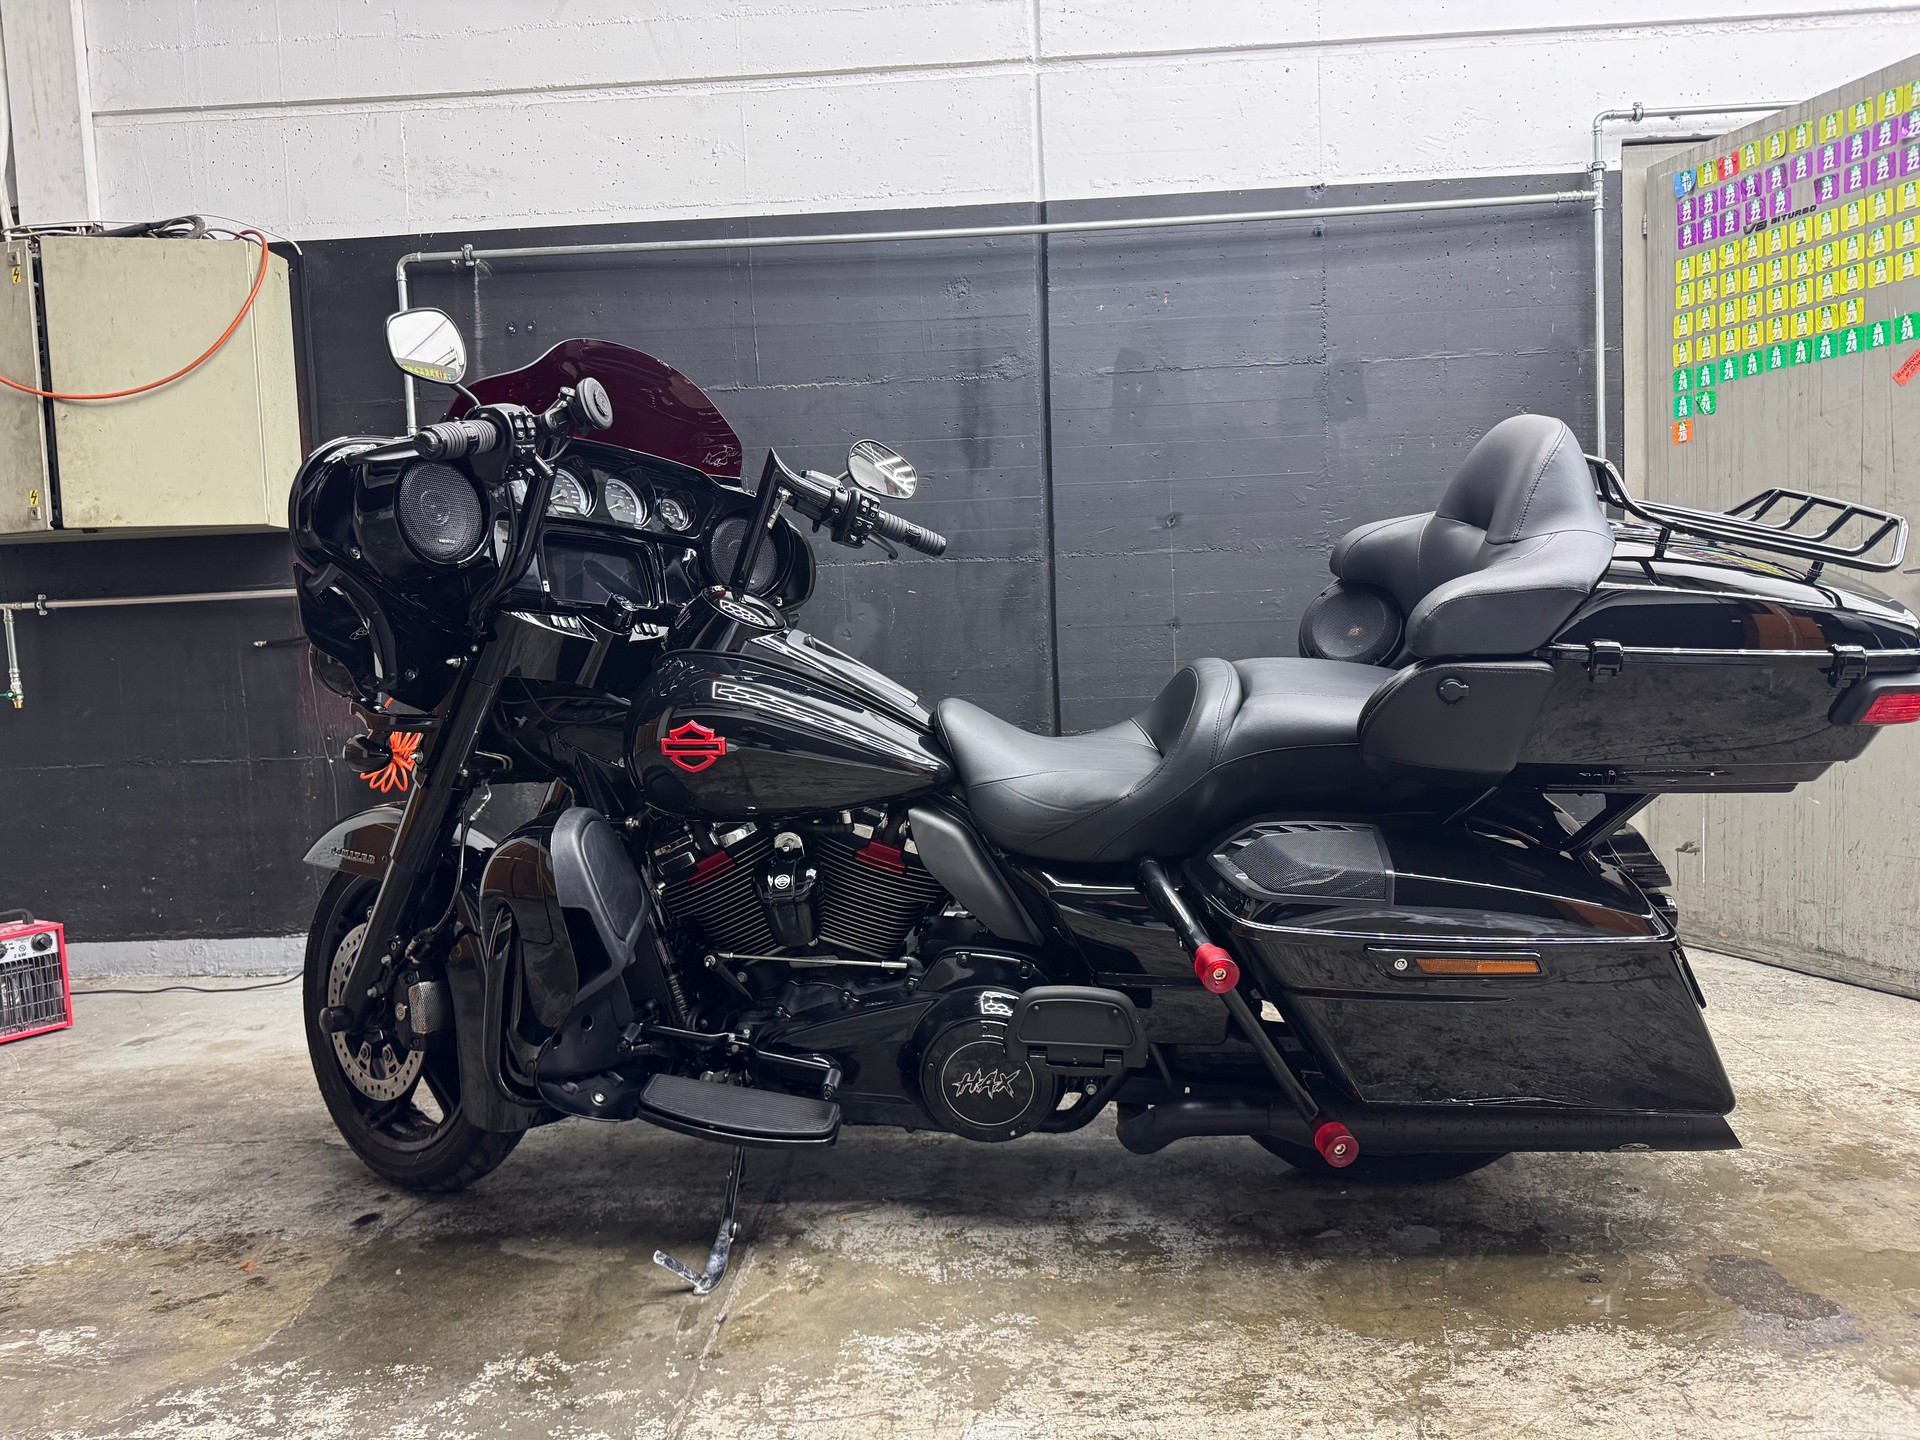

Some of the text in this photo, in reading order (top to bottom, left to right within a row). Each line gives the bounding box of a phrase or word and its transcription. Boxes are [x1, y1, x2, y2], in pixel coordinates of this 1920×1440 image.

[1885, 103, 1896, 117] 21
[1856, 115, 1866, 128] 21
[1826, 125, 1836, 139] 21
[1908, 120, 1920, 136] 22
[1796, 136, 1806, 149] 21
[1879, 133, 1891, 146] 22
[1771, 145, 1780, 159] 21
[1851, 145, 1863, 159] 22
[1746, 156, 1755, 167] 21
[1824, 156, 1834, 169] 22
[1907, 158, 1919, 171] 22
[1724, 166, 1733, 176] 20
[1796, 166, 1806, 179] 22
[1877, 166, 1889, 180] 22
[1704, 173, 1712, 184] 21
[1772, 177, 1781, 189] 22
[1850, 176, 1861, 189] 22
[1682, 181, 1692, 192] 19
[1746, 185, 1756, 197] 22
[1726, 193, 1735, 205] 22
[1822, 187, 1832, 200] 22
[1704, 202, 1713, 214] 22
[1775, 202, 1785, 213] 22
[1683, 210, 1691, 221] 22
[1743, 205, 1816, 234] V8 BITURBO
[1751, 210, 1760, 220] 22
[1725, 221, 1734, 232] 22
[1703, 228, 1712, 239] 22
[1683, 235, 1692, 245] 22
[1901, 325, 1913, 340] 24
[1846, 340, 1857, 352] 24
[1873, 333, 1883, 347] 24
[1796, 351, 1806, 363] 24
[1820, 346, 1831, 358] 24
[1771, 357, 1781, 368] 24
[1724, 369, 1733, 380] 24
[1748, 364, 1757, 375] 24
[1678, 379, 1687, 391] 24
[1701, 375, 1710, 387] 24
[1679, 405, 1687, 416] 24
[1678, 431, 1687, 442] 25
[952, 1067, 1020, 1100] HAX
